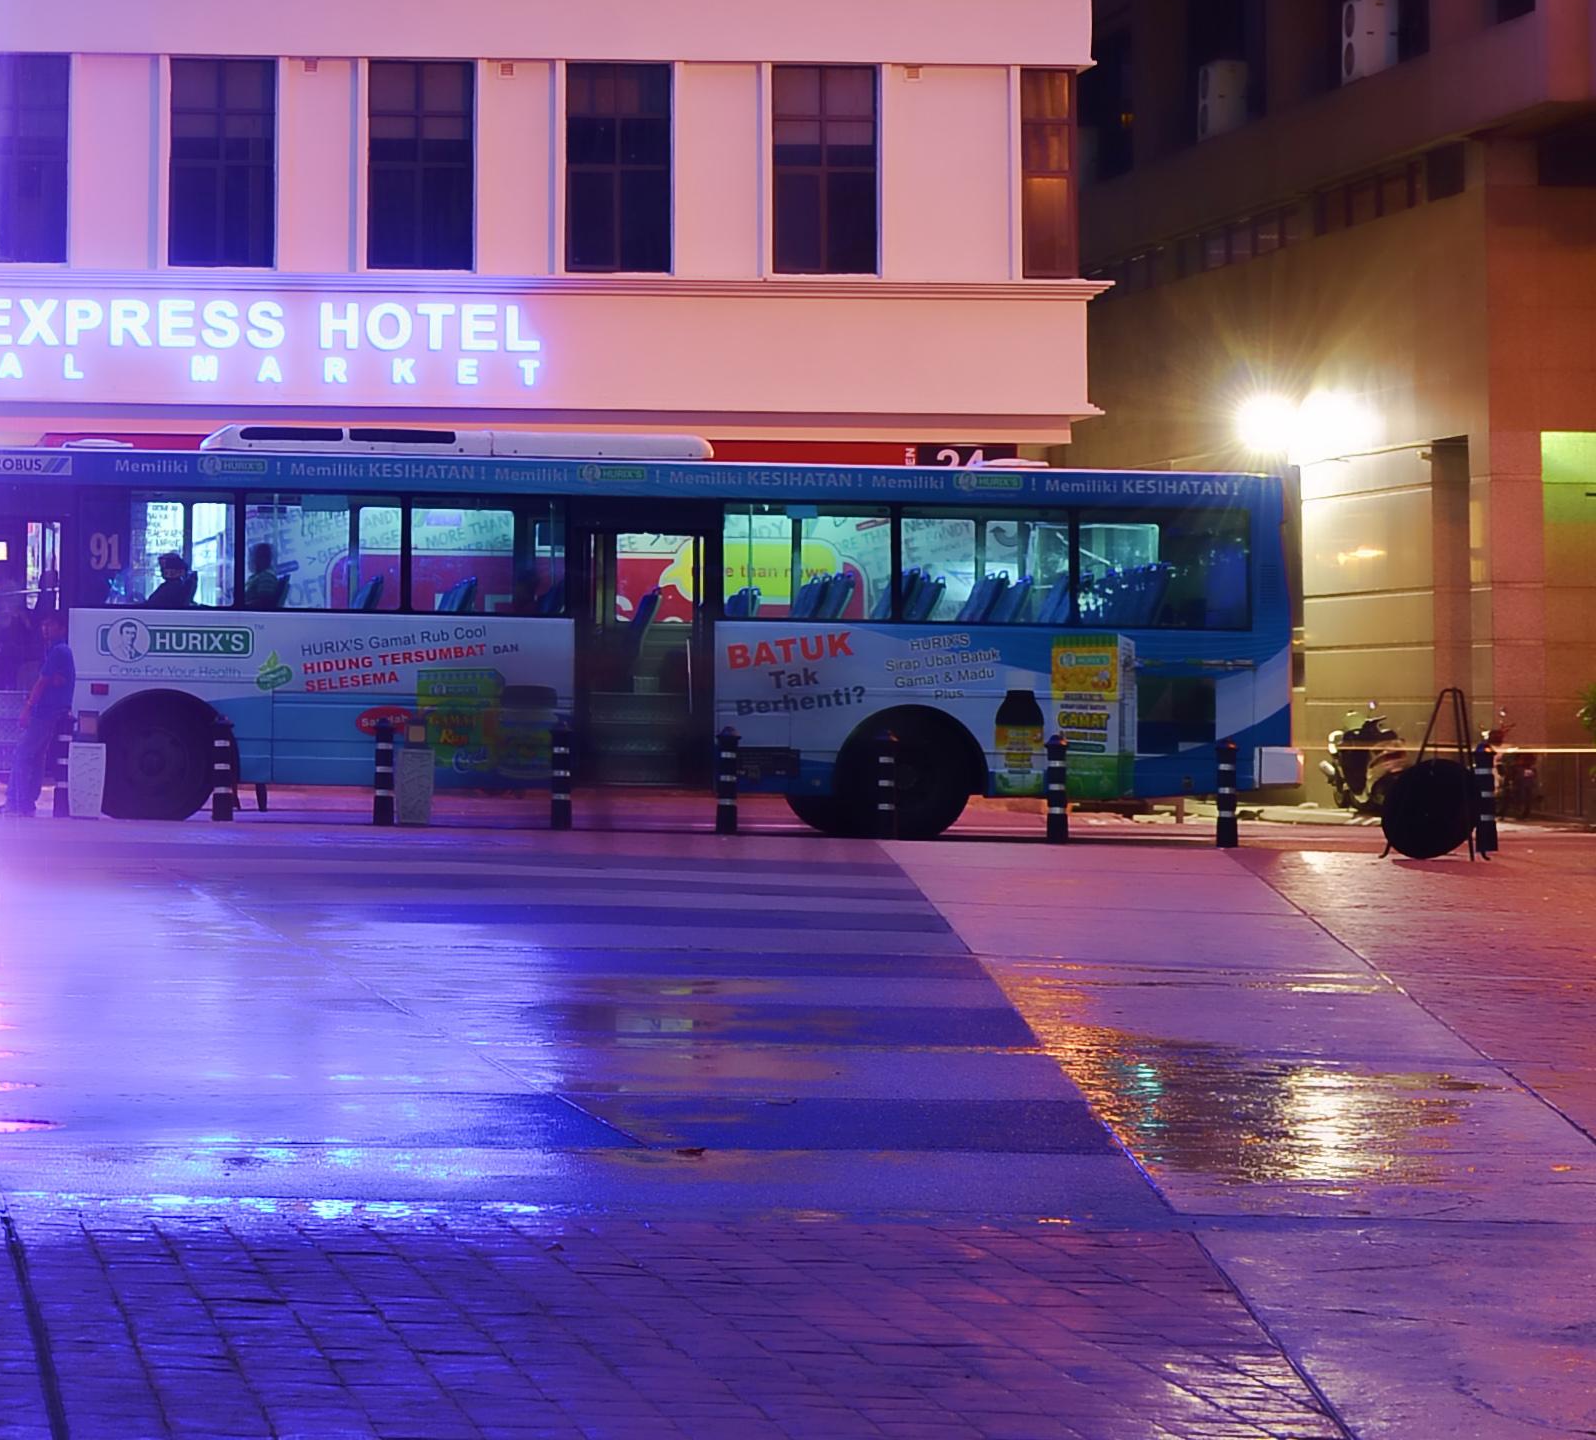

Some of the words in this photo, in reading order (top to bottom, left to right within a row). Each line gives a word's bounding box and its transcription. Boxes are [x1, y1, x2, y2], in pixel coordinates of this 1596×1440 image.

[318, 301, 542, 353] HOTEL
[191, 354, 542, 387] MARKET
[115, 458, 188, 473] Memiliki
[291, 462, 364, 478] Memiliki
[368, 462, 475, 480] KESIHATAN
[494, 467, 568, 482] Memiliki
[669, 470, 743, 486] Memiliki
[747, 470, 853, 488] KESIHATAN
[872, 474, 944, 490] Memiliki
[1045, 478, 1117, 494] Memiliki
[1122, 478, 1229, 496] KESIHATAN
[90, 532, 122, 570] 91
[155, 631, 245, 652] HURIX'S
[301, 638, 364, 657] HURIX'S
[368, 633, 417, 650] Gamat
[421, 628, 450, 644] Rub
[454, 625, 487, 640] Cool
[726, 631, 854, 670] BATUK
[910, 633, 970, 652] HURIX'S
[302, 655, 373, 675] HIDUNG
[378, 643, 487, 667] TERSUMBAT
[493, 643, 520, 655] DAN
[885, 657, 921, 673] Sirap
[925, 653, 957, 668] Ubat
[960, 648, 1001, 664] Batuk
[305, 671, 400, 693] SELESEMA
[768, 668, 819, 690] Tak
[894, 673, 941, 689] Gamat
[957, 667, 995, 683] Madu
[934, 687, 965, 701] Plus
[735, 685, 866, 717] Berhenti?
